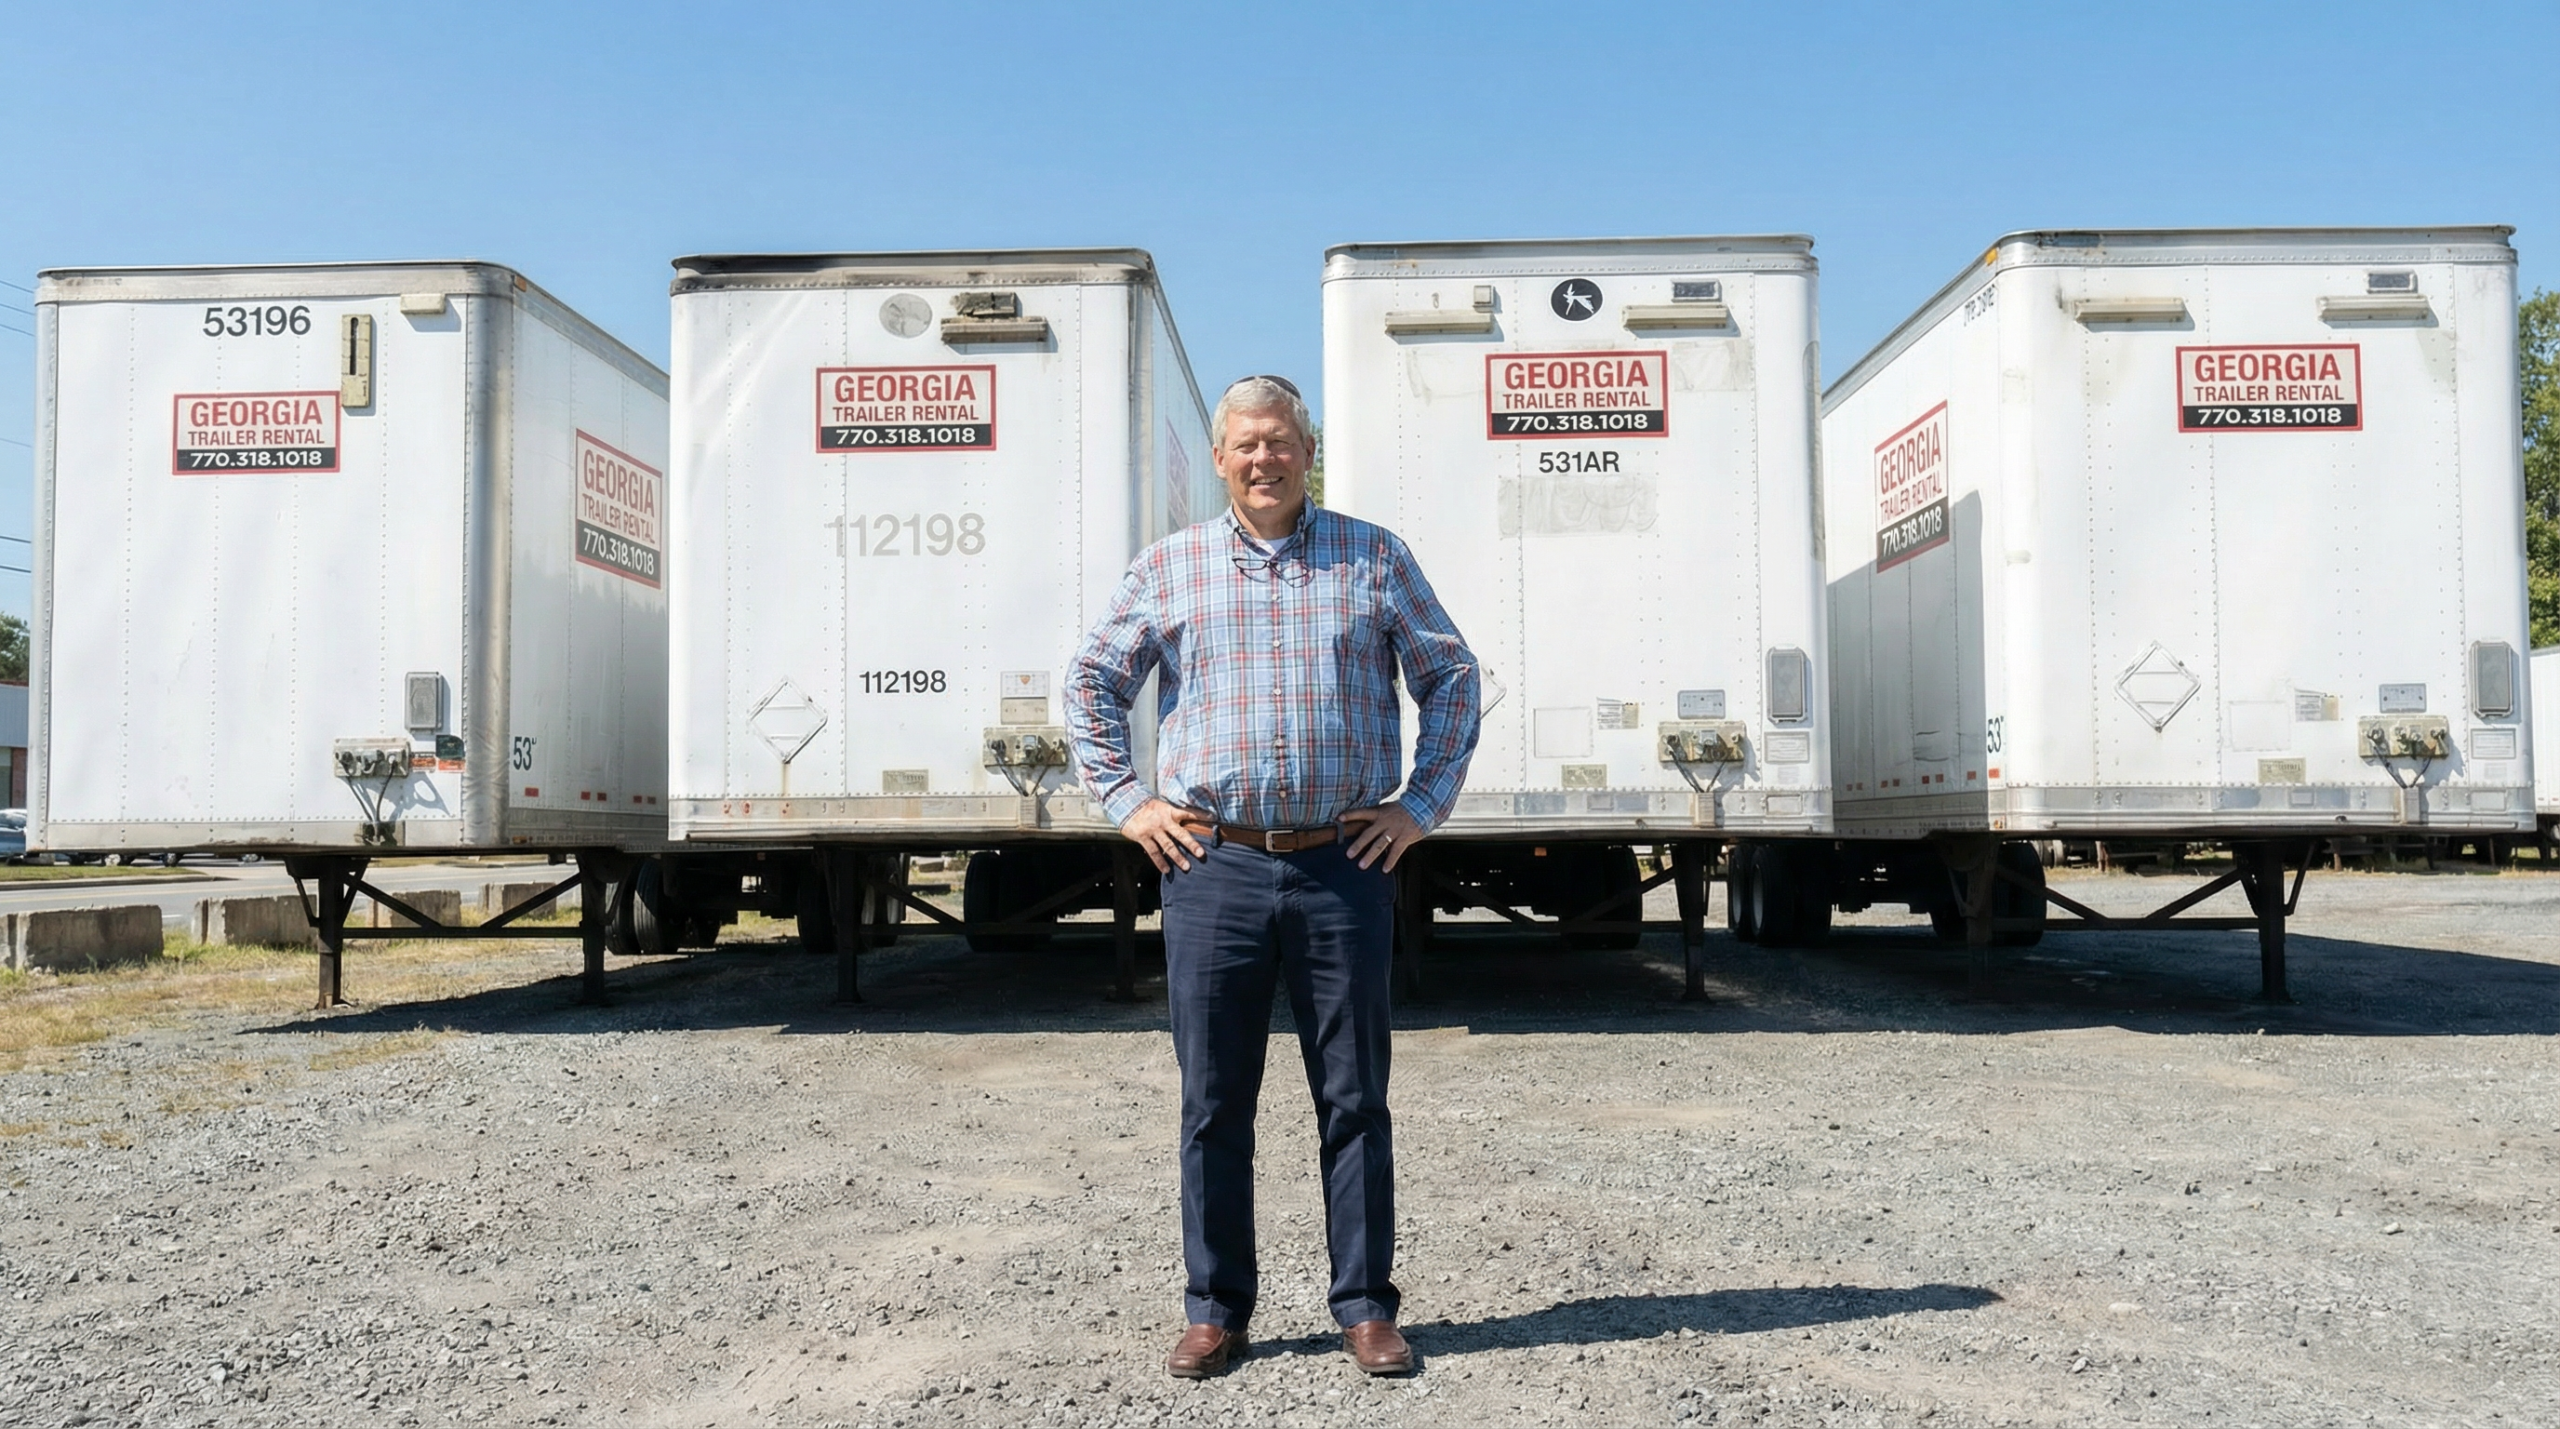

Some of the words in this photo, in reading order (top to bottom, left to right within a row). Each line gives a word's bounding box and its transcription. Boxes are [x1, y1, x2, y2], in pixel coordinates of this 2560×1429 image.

[203, 305, 311, 337] 53196
[1505, 360, 1649, 390] GEORGIA
[2194, 353, 2341, 382] GEORGIA
[835, 374, 976, 403] GEORGIA
[1502, 392, 1577, 410] TRAILER
[1583, 391, 1651, 408] RENTAL
[2194, 385, 2269, 402] TRAILER
[2276, 384, 2344, 401] RENTAL
[190, 400, 323, 427] GEORGIA
[832, 406, 906, 423] TRAILER
[912, 405, 979, 421] RENTAL
[1507, 413, 1648, 432] 770.318.1018
[2198, 407, 2342, 425] 770.318.1018
[187, 430, 256, 446] TRAILER
[262, 429, 325, 445] RENTAL
[835, 427, 976, 445] 770.318.1018
[190, 451, 322, 468] 770.318.1018
[1539, 451, 1620, 474] 531AR
[1880, 421, 1942, 495] GEORGIA
[583, 449, 655, 518] GEORGIA
[582, 492, 621, 531] TRAILER
[623, 511, 655, 545] RENTAL
[1882, 506, 1943, 557] 770.318.1018
[827, 512, 986, 557] 112198
[583, 528, 654, 575] 770.318.1018
[859, 670, 947, 694] 112198
